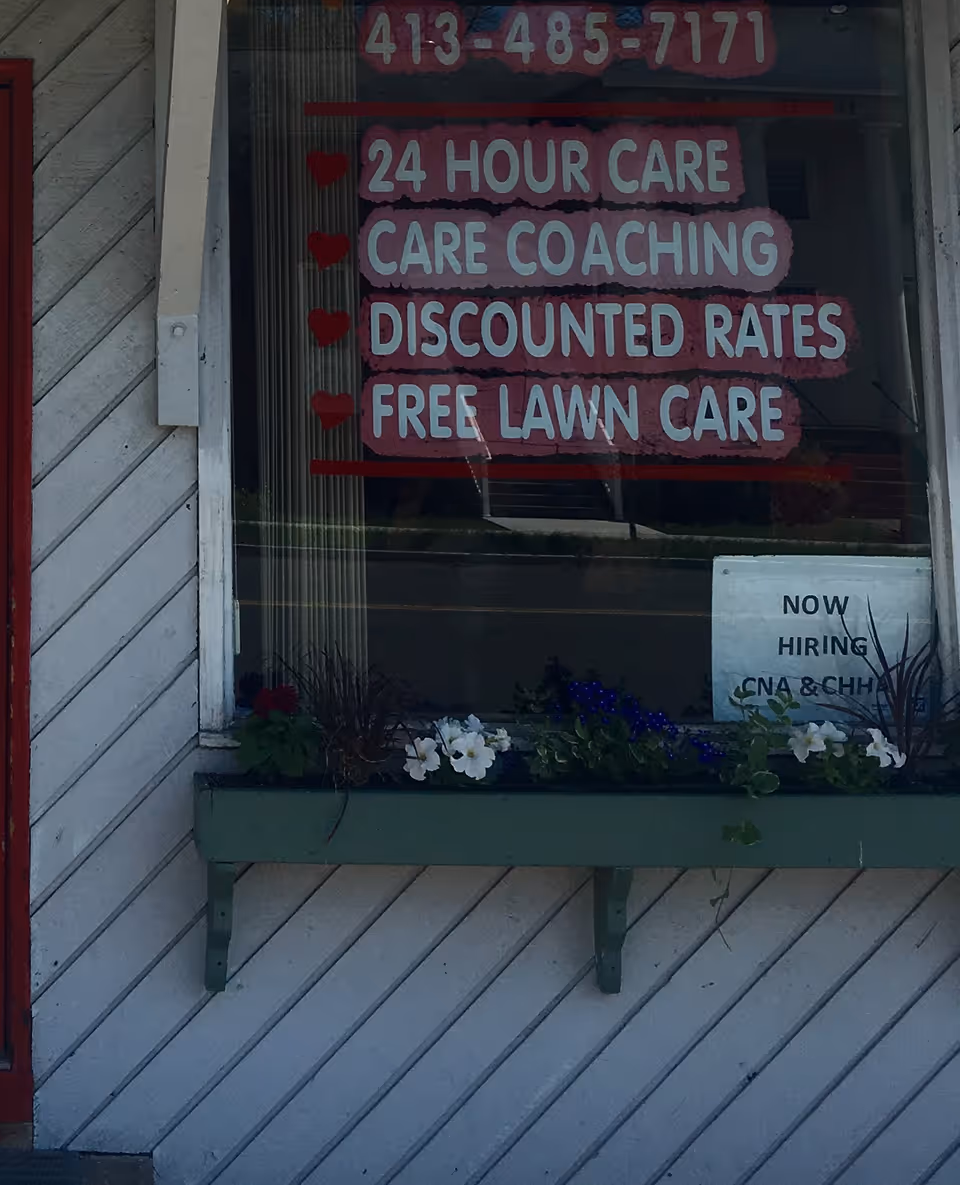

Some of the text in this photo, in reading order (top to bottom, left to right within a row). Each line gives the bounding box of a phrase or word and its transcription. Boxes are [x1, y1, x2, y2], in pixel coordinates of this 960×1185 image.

[365, 10, 766, 66] 413-485-7171
[367, 139, 731, 195] 24 HOUR CARE
[367, 220, 779, 278] CARE COACHING
[370, 301, 847, 360] DISCOUNTED RATES
[371, 384, 785, 442] FREE LAWN CARE
[783, 594, 849, 614] NOW
[778, 635, 868, 656] HIRING
[742, 676, 792, 696] CNA
